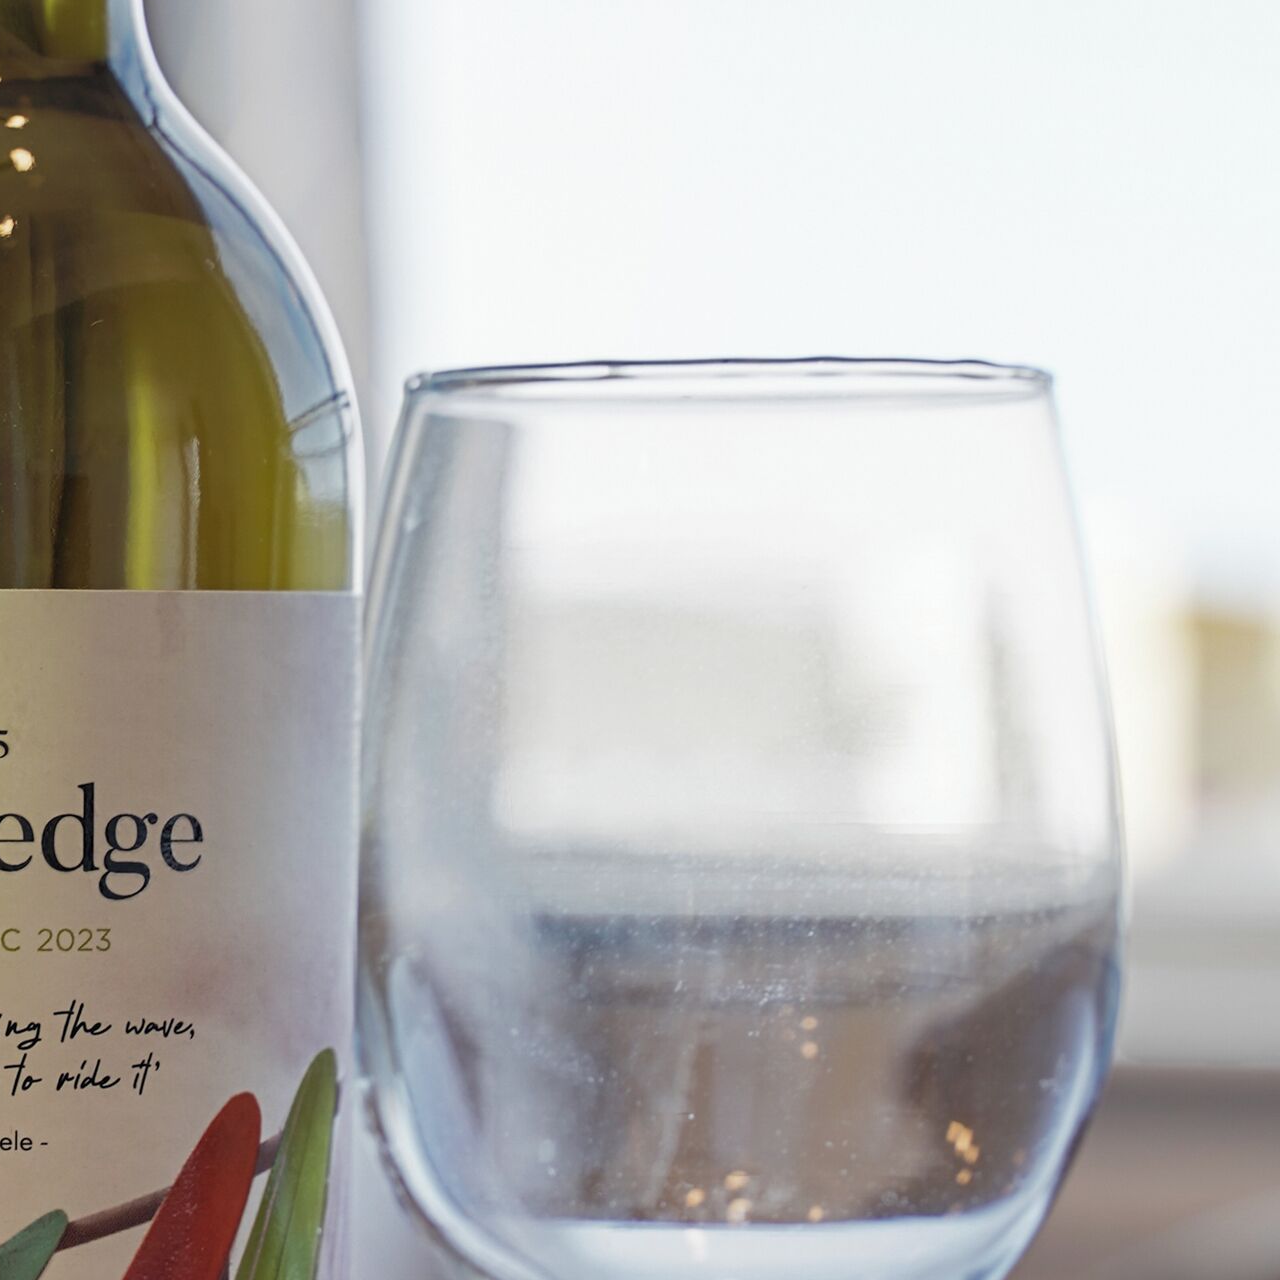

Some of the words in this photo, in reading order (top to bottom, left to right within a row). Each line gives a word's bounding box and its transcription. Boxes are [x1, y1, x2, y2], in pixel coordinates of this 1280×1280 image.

[36, 928, 112, 952] 2023
[53, 999, 112, 1043] the
[125, 1017, 196, 1040] wave,
[4, 1053, 43, 1096] to
[56, 1059, 121, 1091] ride
